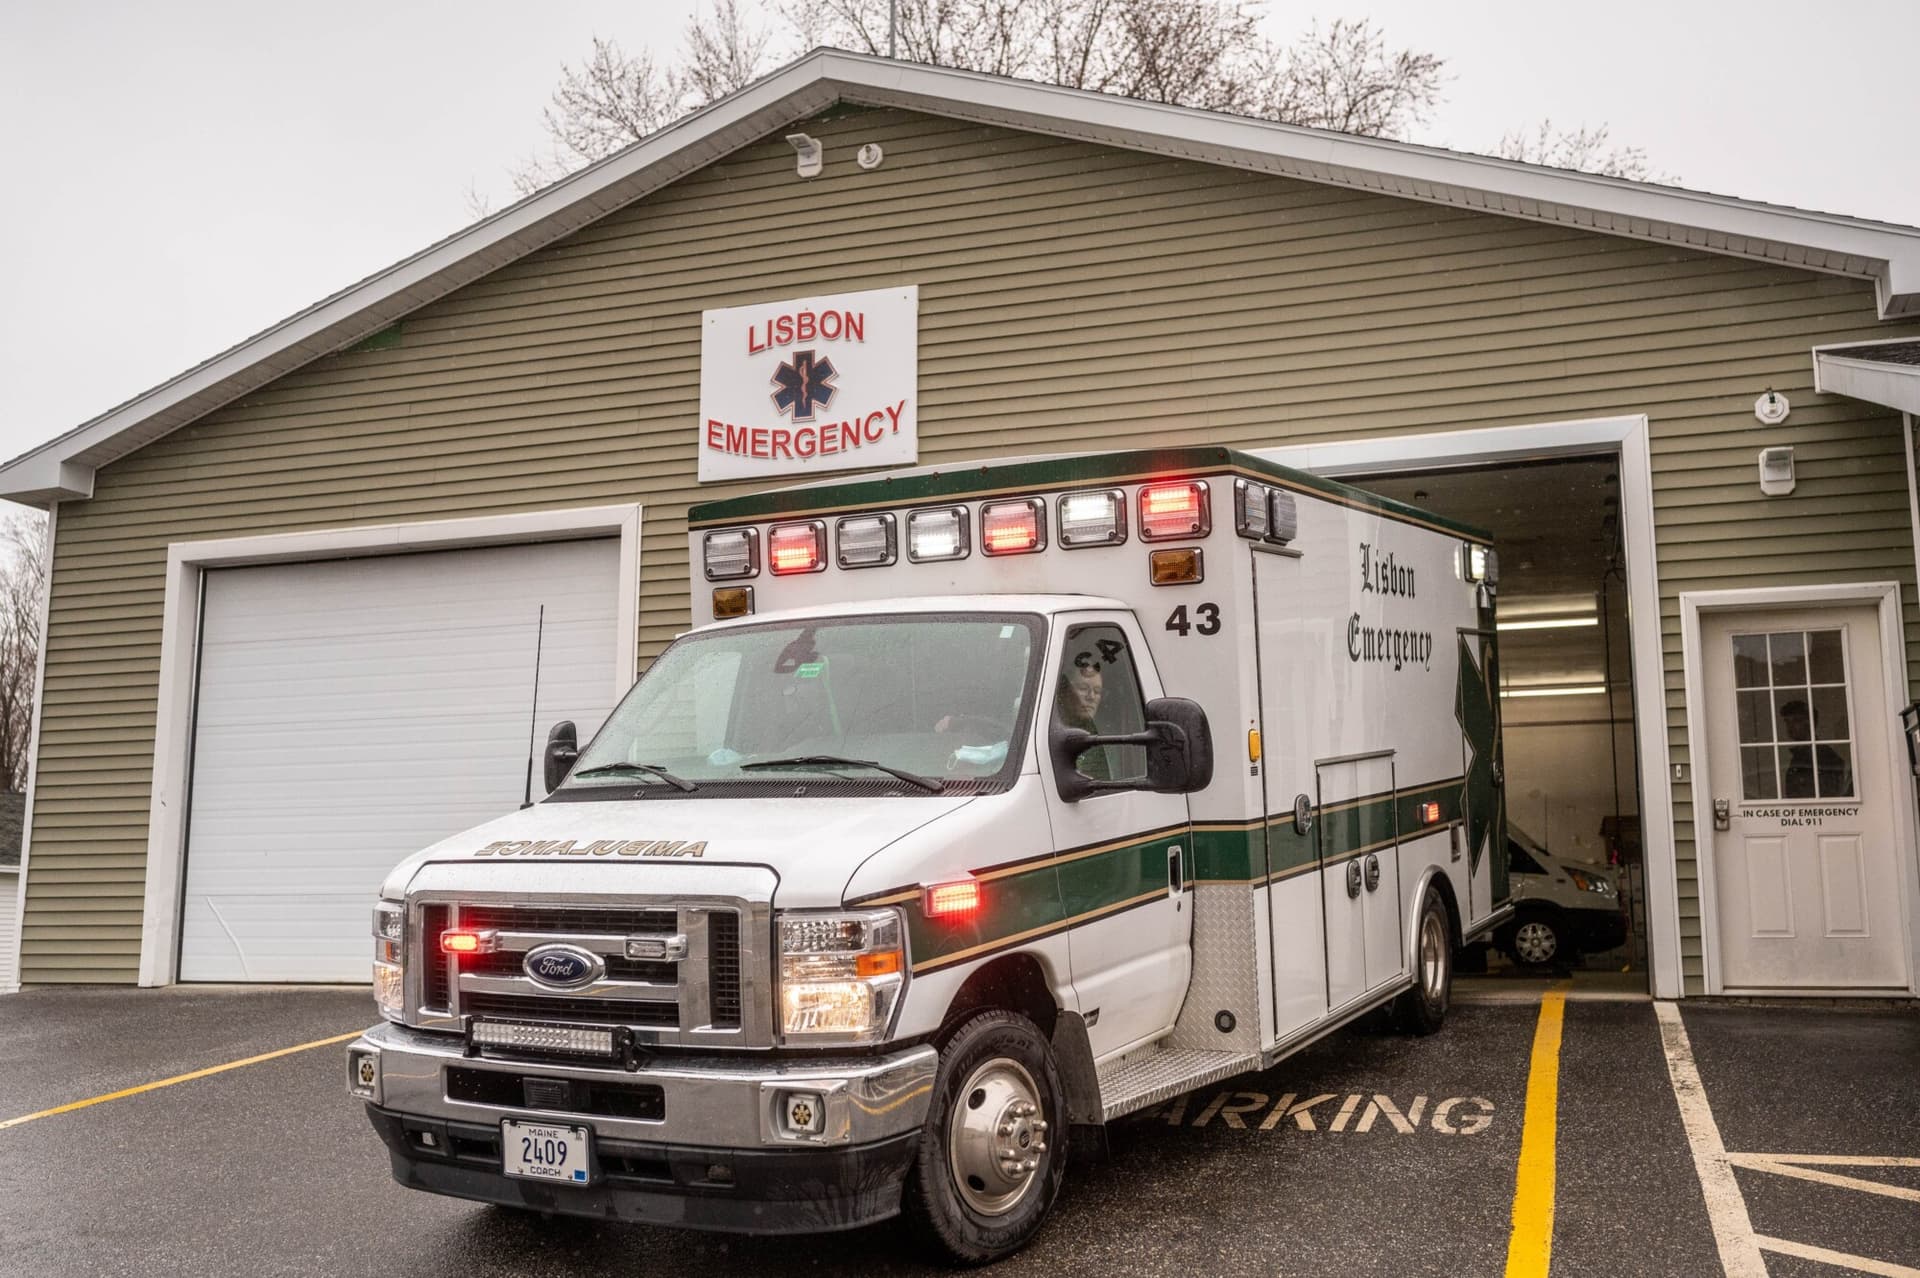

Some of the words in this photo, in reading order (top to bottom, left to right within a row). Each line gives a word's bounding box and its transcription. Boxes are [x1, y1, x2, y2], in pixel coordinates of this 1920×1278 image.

[748, 310, 865, 356] LISBON
[707, 400, 905, 459] EMERGENCY
[1360, 542, 1415, 599] Lisbon
[1166, 603, 1221, 636] 43
[1347, 612, 1432, 672] Emergency
[1743, 809, 1753, 817] IN
[1756, 809, 1780, 817] CASE
[1782, 809, 1796, 817] OF
[1798, 808, 1859, 817] EMERGENCY
[1781, 818, 1803, 826] DIAL
[1805, 818, 1822, 826] 911
[539, 956, 574, 976] Ford
[1140, 1092, 1496, 1135] ARKING
[528, 1128, 559, 1139] MAINE
[521, 1137, 567, 1166] 2409
[530, 1166, 561, 1177] COACH
